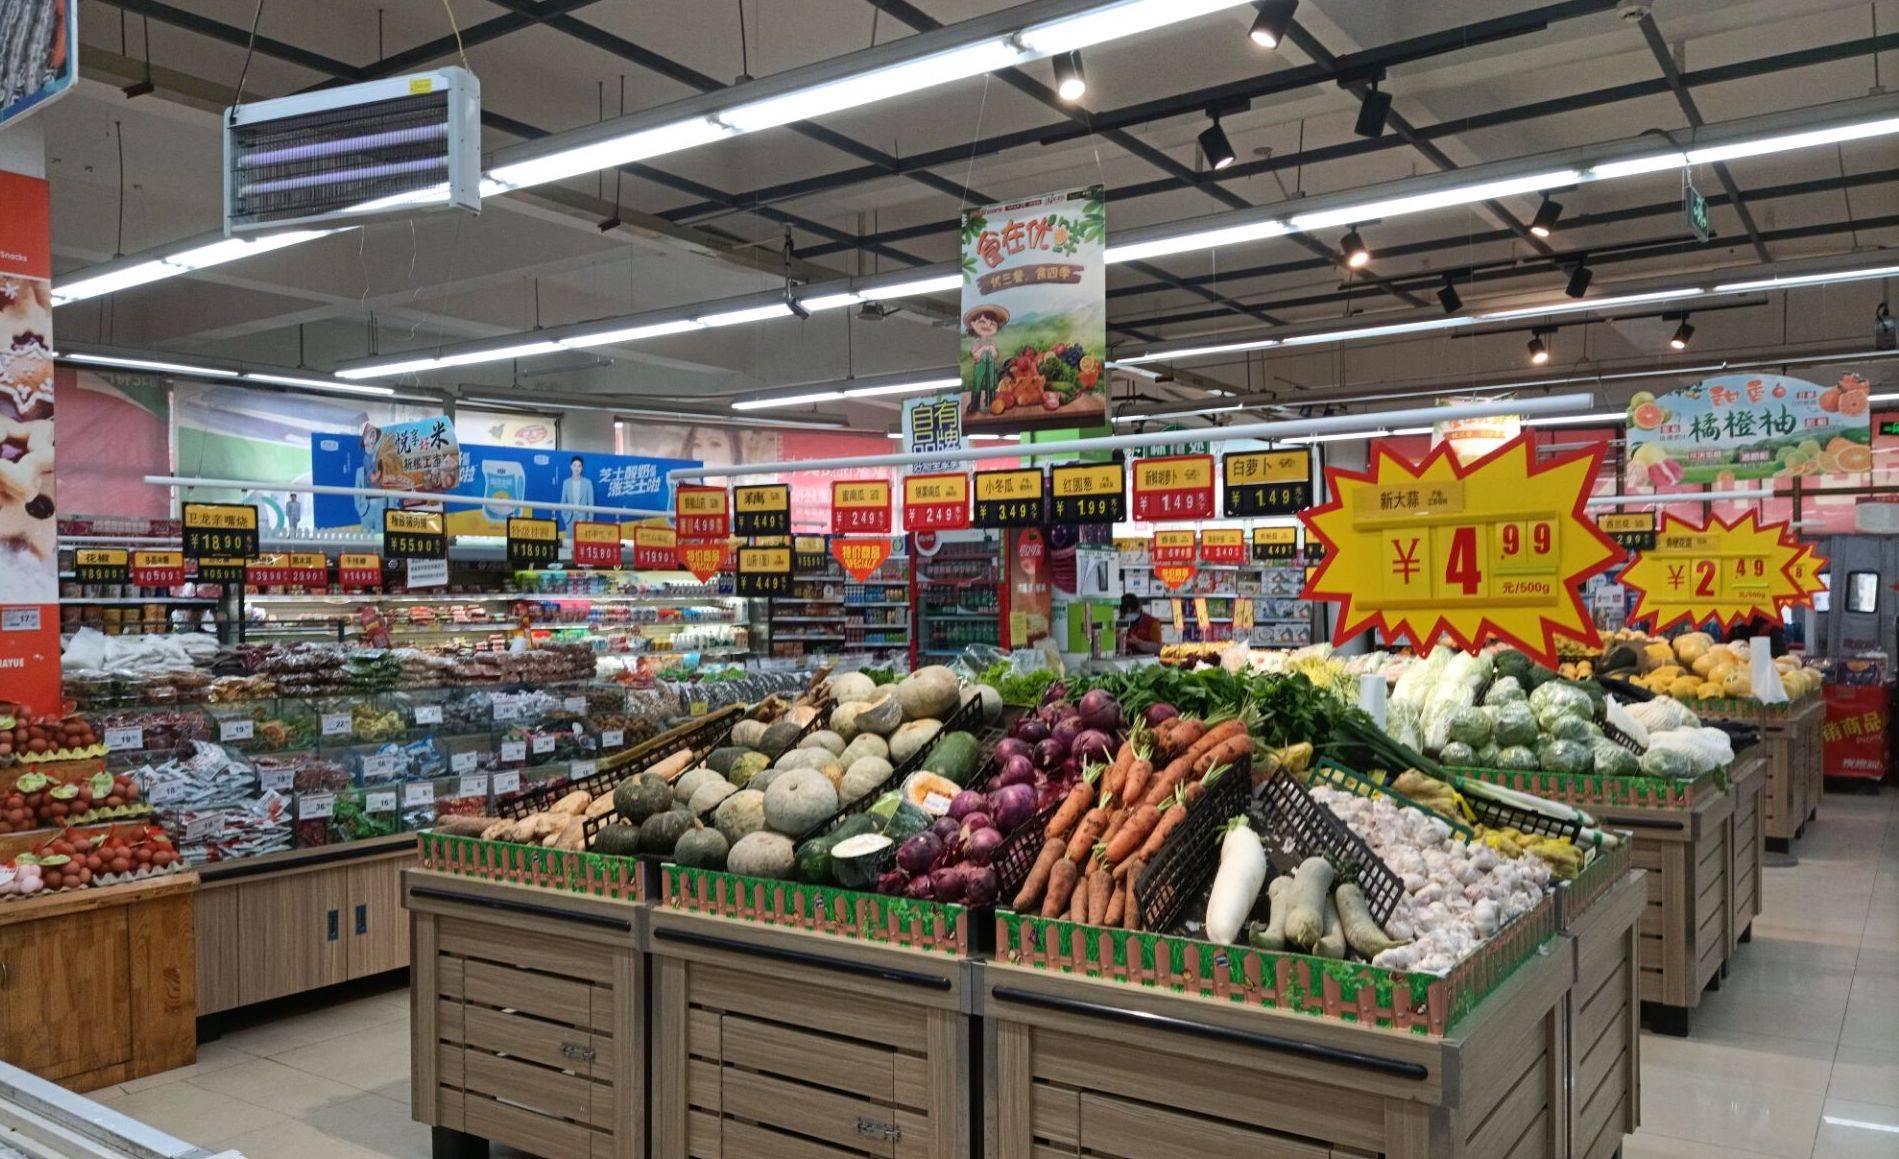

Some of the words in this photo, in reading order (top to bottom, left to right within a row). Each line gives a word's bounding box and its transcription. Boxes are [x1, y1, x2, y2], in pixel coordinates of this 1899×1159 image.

[1689, 404, 1797, 442] 橘橙柚
[1233, 457, 1272, 476] 白萝卜
[986, 478, 1014, 495] 小冬瓜
[1380, 490, 1420, 510] 新大蒜
[189, 512, 249, 527] 卫龙亲嘴烧
[1502, 581, 1551, 595] 元/500g
